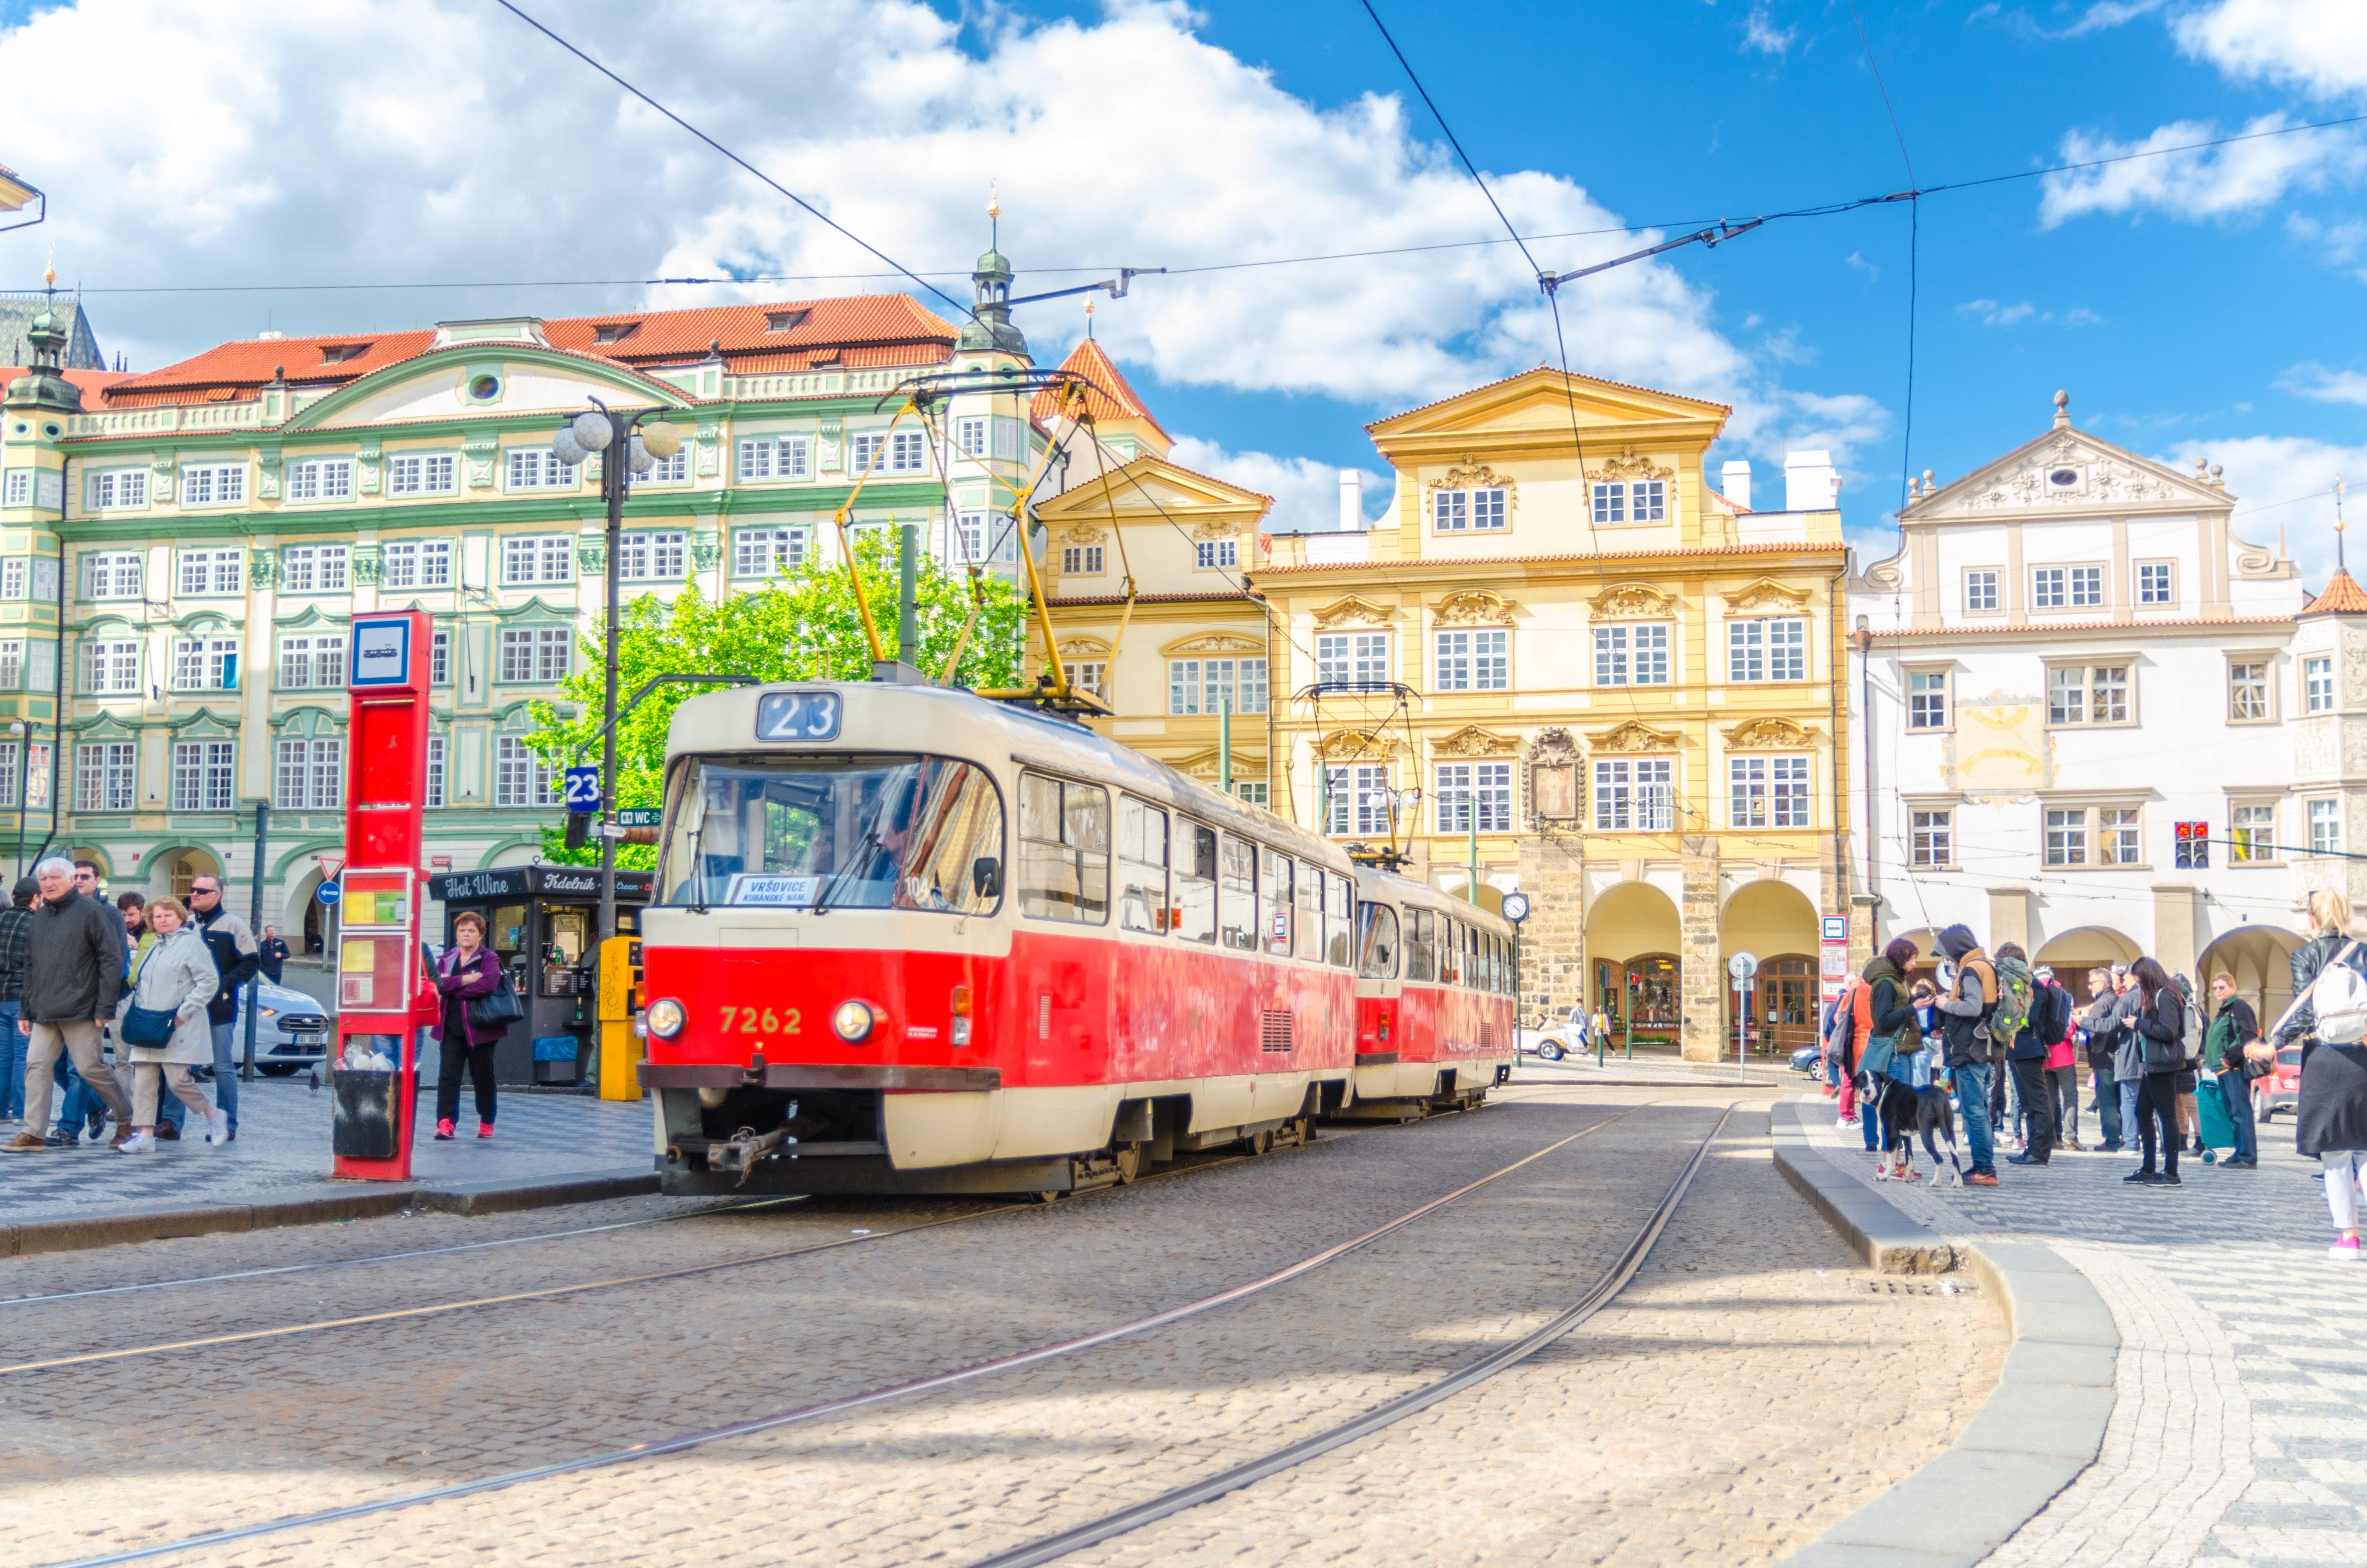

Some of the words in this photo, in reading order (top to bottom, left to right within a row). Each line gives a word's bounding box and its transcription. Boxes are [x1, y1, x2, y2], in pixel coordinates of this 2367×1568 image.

[768, 694, 834, 736] 23
[567, 774, 599, 802] 23
[635, 811, 650, 824] WC
[445, 877, 472, 898] Hot
[473, 874, 508, 895] Wine
[616, 882, 638, 890] Cream
[751, 880, 806, 892] VRŠOVICE
[905, 877, 930, 899] 104
[743, 893, 785, 902] KUBÁNSKÉ
[786, 893, 806, 901] NÁM.
[721, 1006, 801, 1034] 7262
